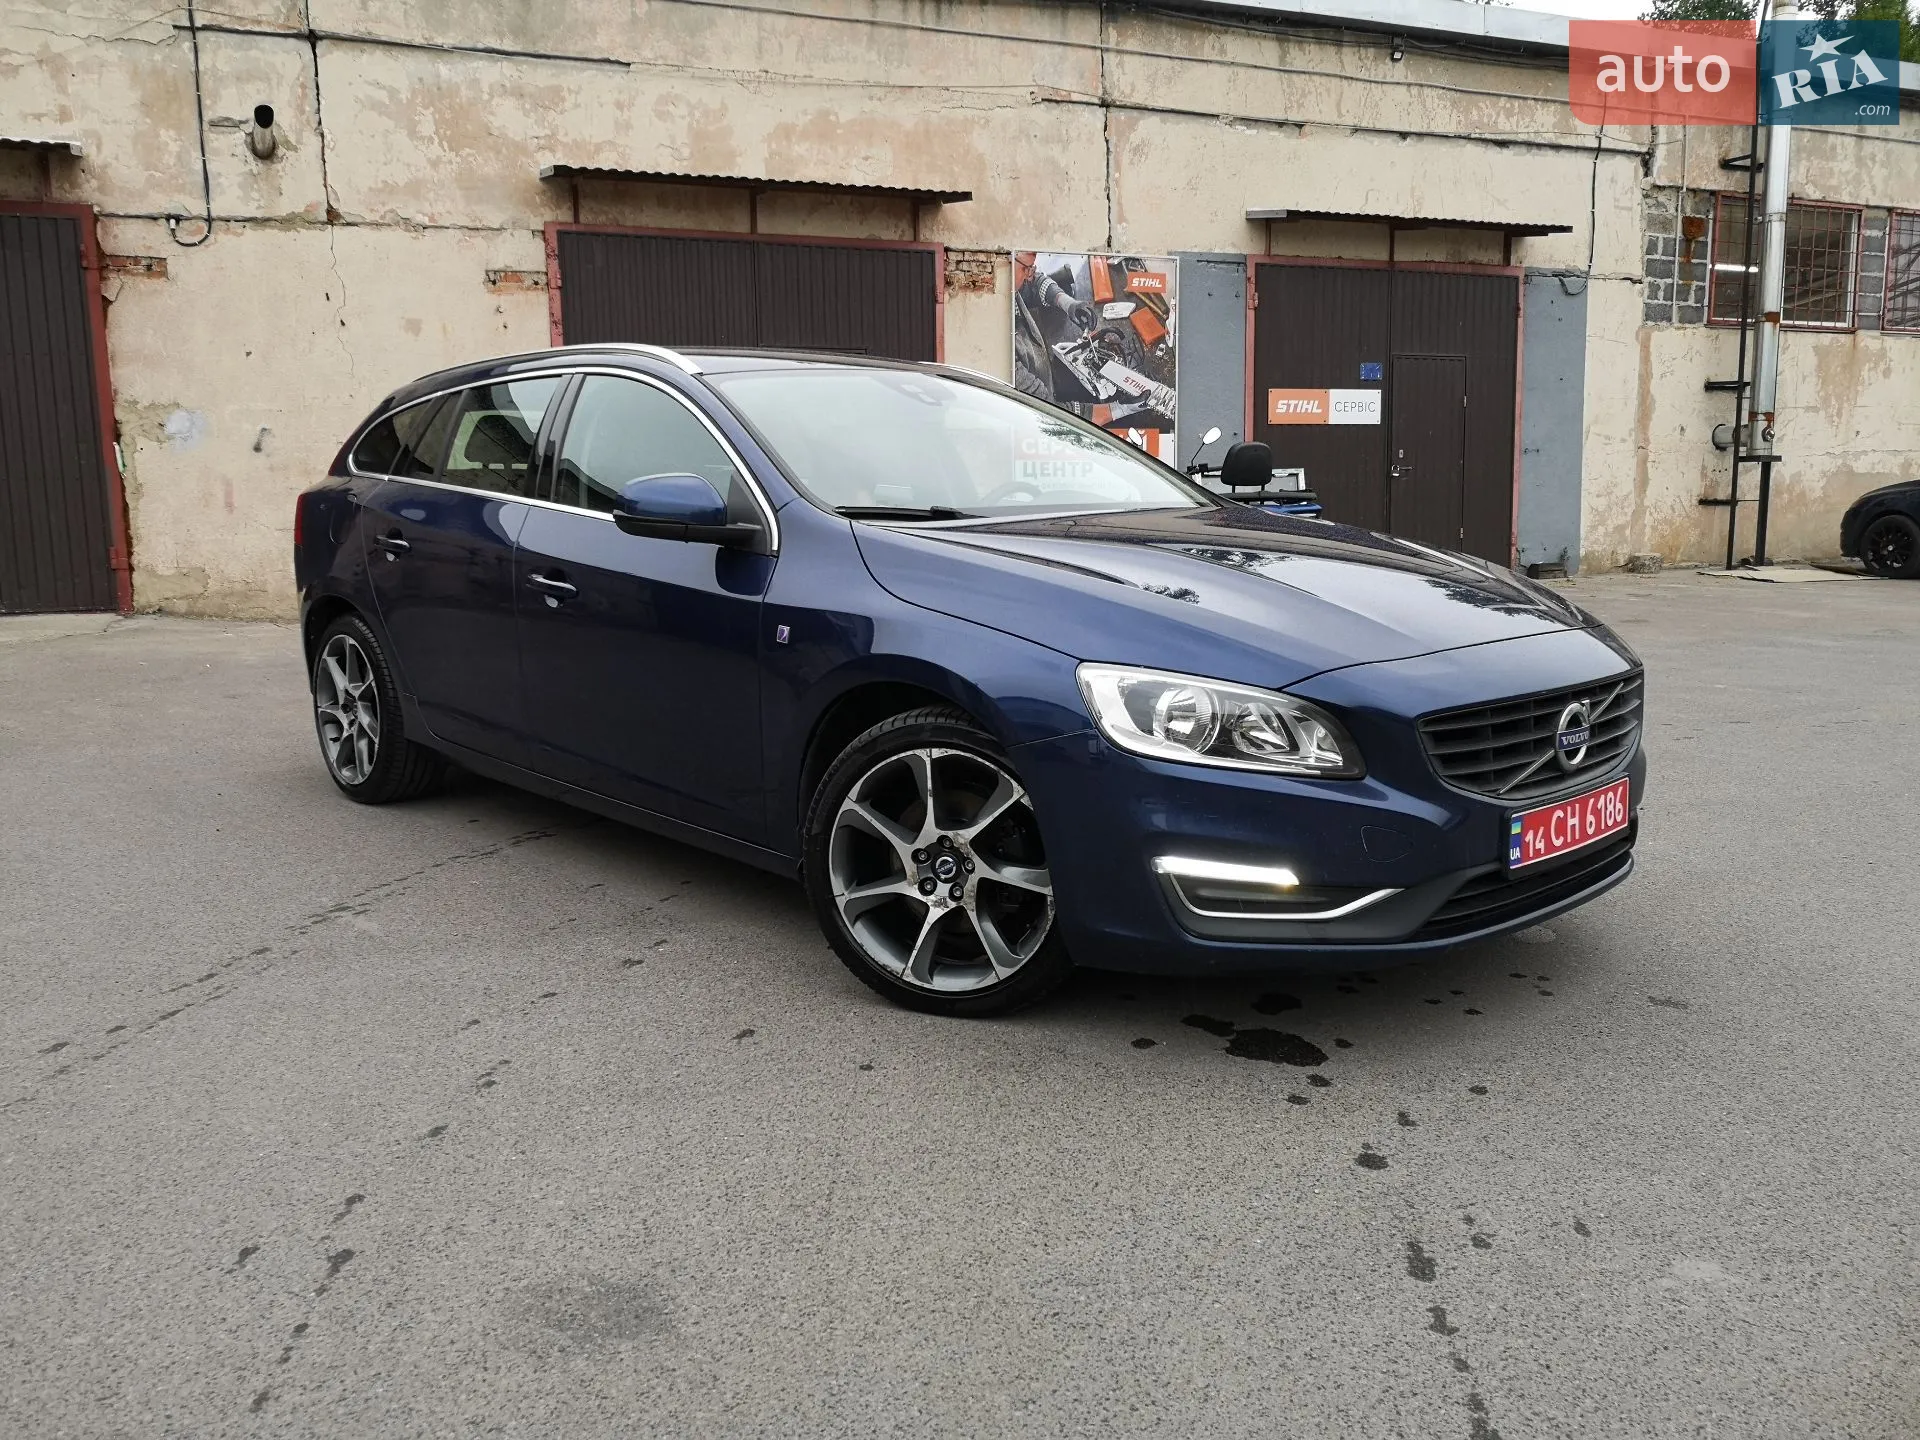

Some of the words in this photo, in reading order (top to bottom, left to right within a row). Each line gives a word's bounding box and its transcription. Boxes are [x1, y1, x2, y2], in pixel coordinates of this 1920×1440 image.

[1131, 277, 1163, 288] STIHL
[1275, 400, 1322, 413] STIHL
[1334, 401, 1376, 413] СЕРВІС
[1022, 461, 1093, 479] ЦЕНТР
[1561, 730, 1589, 745] VOLVO
[1524, 826, 1545, 858] 14
[1550, 803, 1580, 847] CH
[1585, 786, 1624, 836] 6186
[1510, 848, 1521, 860] UA
